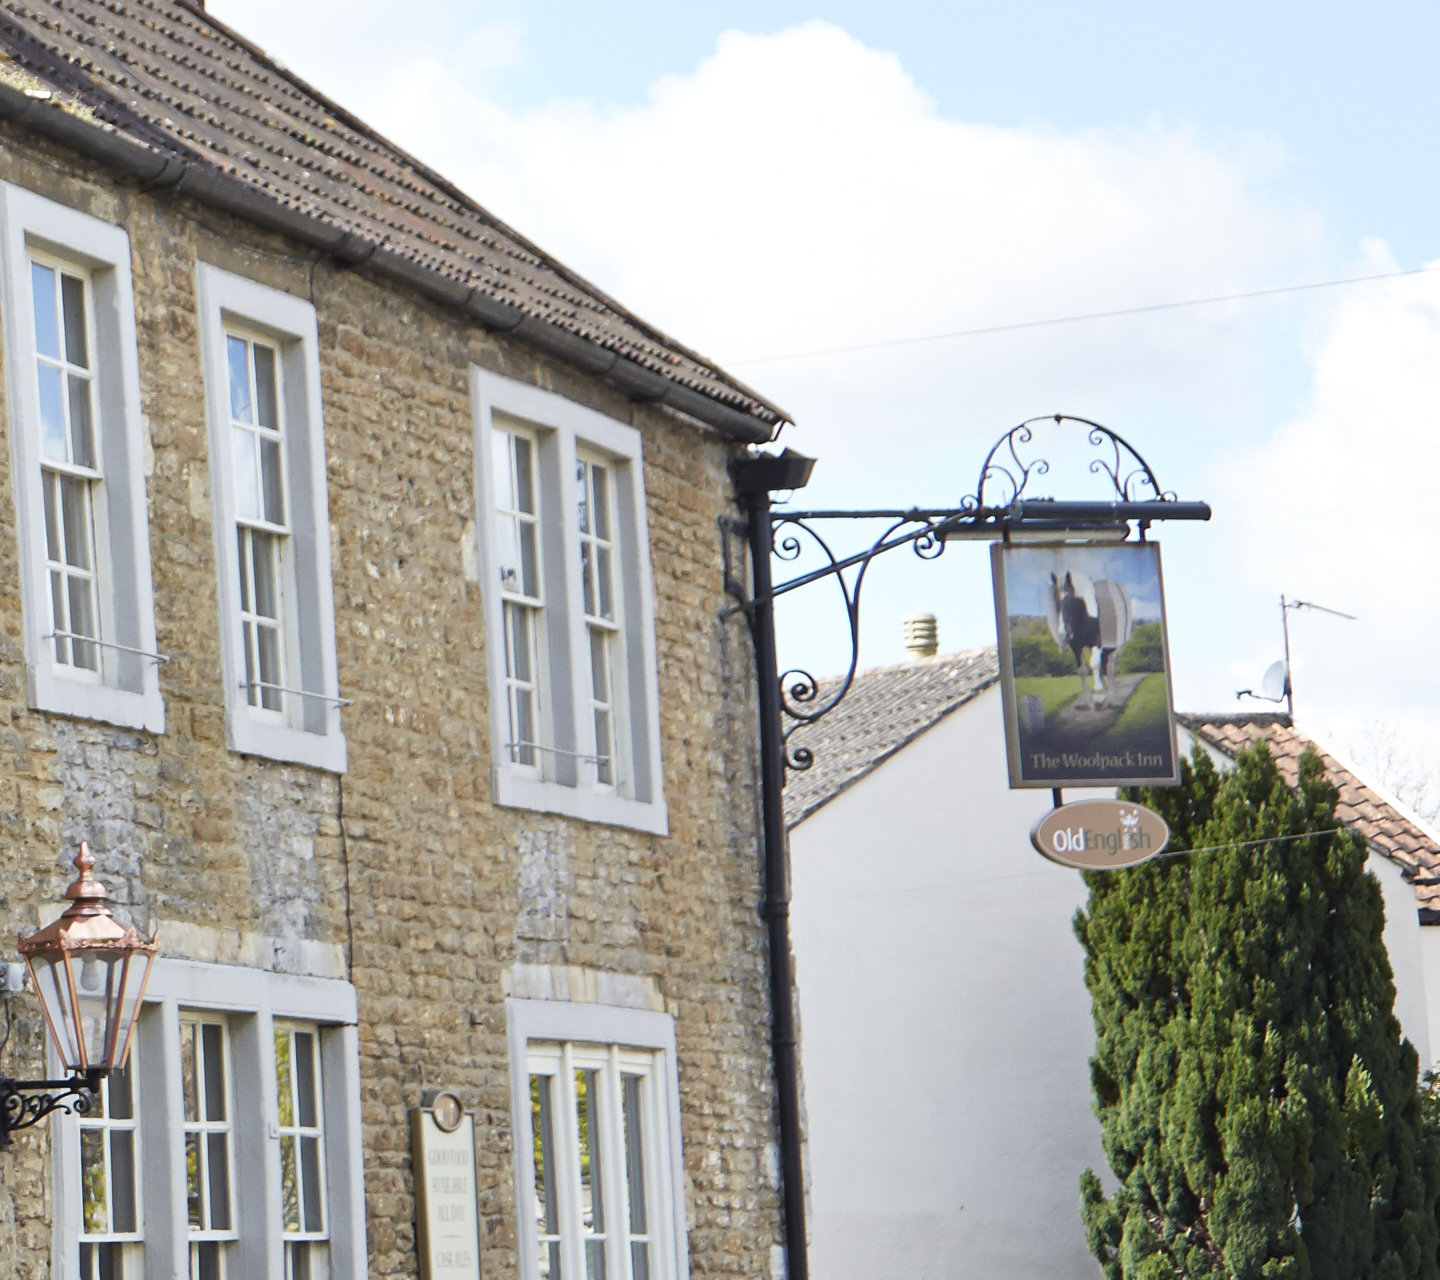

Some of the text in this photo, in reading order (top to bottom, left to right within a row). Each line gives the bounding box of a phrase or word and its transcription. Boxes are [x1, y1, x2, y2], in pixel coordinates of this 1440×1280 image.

[1031, 752, 1163, 771] The Woolpack Inn
